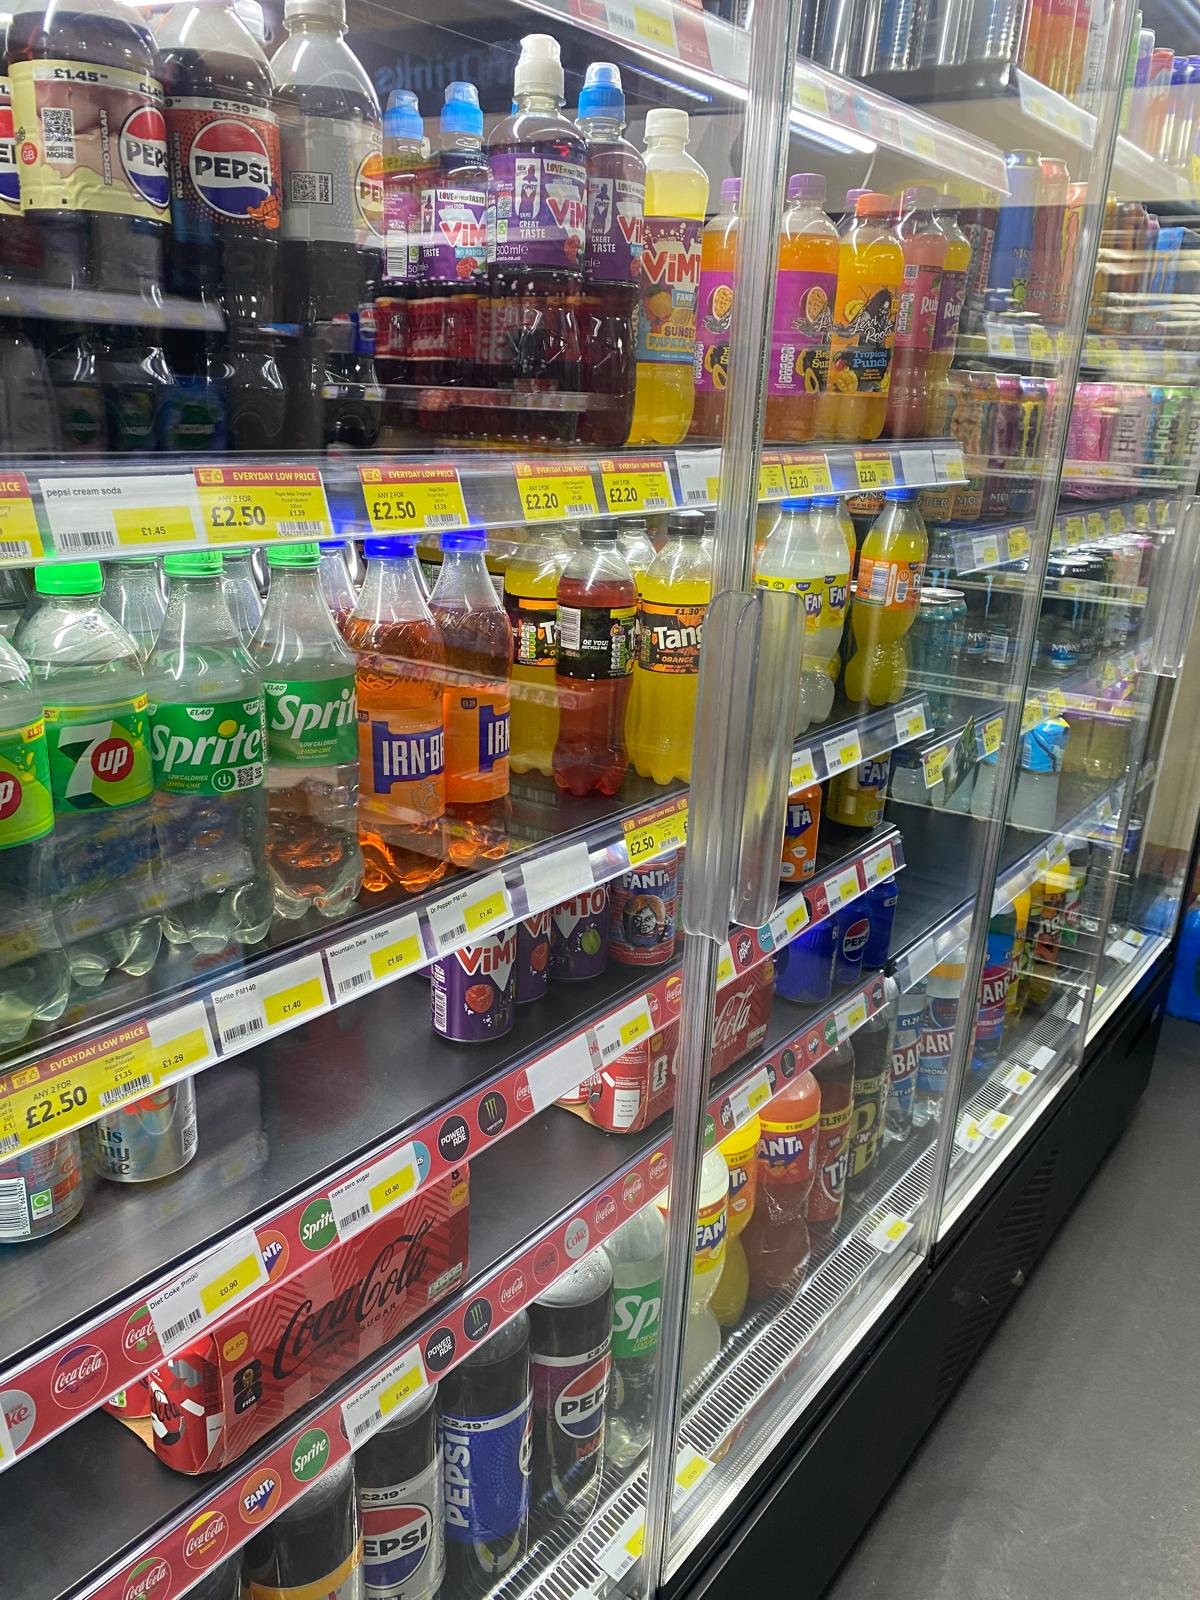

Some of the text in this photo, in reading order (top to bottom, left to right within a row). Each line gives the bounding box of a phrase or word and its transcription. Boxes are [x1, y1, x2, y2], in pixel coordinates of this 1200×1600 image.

[54, 68, 98, 82] £1.45
[212, 100, 250, 114] £1.39
[46, 152, 74, 160] MORE
[519, 220, 540, 228] GREAT
[520, 228, 546, 239] TASTE
[423, 248, 440, 258] TASTE
[592, 244, 616, 253] TASTE
[853, 358, 887, 368] Punch
[388, 470, 454, 479] EVERYDAY LOW PRICE
[536, 466, 562, 474] EVERYDAY
[574, 464, 588, 472] PRICE
[860, 470, 876, 482] £2.20
[232, 472, 317, 481] EVERYDAY LOW PRICE
[790, 476, 808, 490] £2.20
[46, 486, 122, 498] pepsi cream soda
[610, 486, 638, 503] £2.20
[526, 492, 558, 510] £2.20
[212, 506, 266, 527] £2.50
[373, 500, 416, 520] £2.50
[141, 526, 166, 536] £1.45
[674, 608, 699, 616] £1.30
[661, 655, 694, 664] ORANGE
[152, 720, 262, 773] Sprite
[180, 774, 208, 782] CALORIES
[630, 836, 654, 856] £2.50
[622, 869, 670, 889] FANTA
[436, 900, 452, 912] Pepper
[480, 907, 493, 919] £1.40
[330, 944, 355, 958] Mountain
[356, 938, 368, 948] Dew
[214, 984, 256, 1004] Sprite PM140
[282, 1000, 301, 1013] £1.40
[50, 1026, 146, 1072] EVERYDAY LOW PRICE
[162, 1053, 184, 1069] £1.29
[114, 1070, 132, 1082] £1.35
[33, 1089, 50, 1101] ANY
[56, 1079, 72, 1092] FOR
[26, 1086, 88, 1130] £2.50
[440, 1125, 465, 1146] POWER
[330, 1188, 344, 1198] coke
[356, 1172, 370, 1185] sugar
[384, 1184, 400, 1197] £0.90
[566, 1230, 586, 1250] Coke
[219, 1280, 238, 1297] £0.90
[150, 1298, 164, 1310] Diet
[164, 1286, 181, 1300] Coke
[360, 1302, 397, 1333] SUGAR
[427, 1335, 452, 1359] POWER
[360, 1390, 370, 1400] Cola
[370, 1382, 381, 1392] Zero
[396, 1386, 410, 1400] £4.50
[242, 1394, 256, 1408] FIFA
[442, 1418, 483, 1429] £2.49
[294, 1440, 328, 1473] Sprite
[446, 1432, 471, 1528] PEPSI
[242, 1478, 275, 1510] FANTA
[361, 1490, 399, 1501] £2.19
[186, 1516, 225, 1557] Coca-Cola
